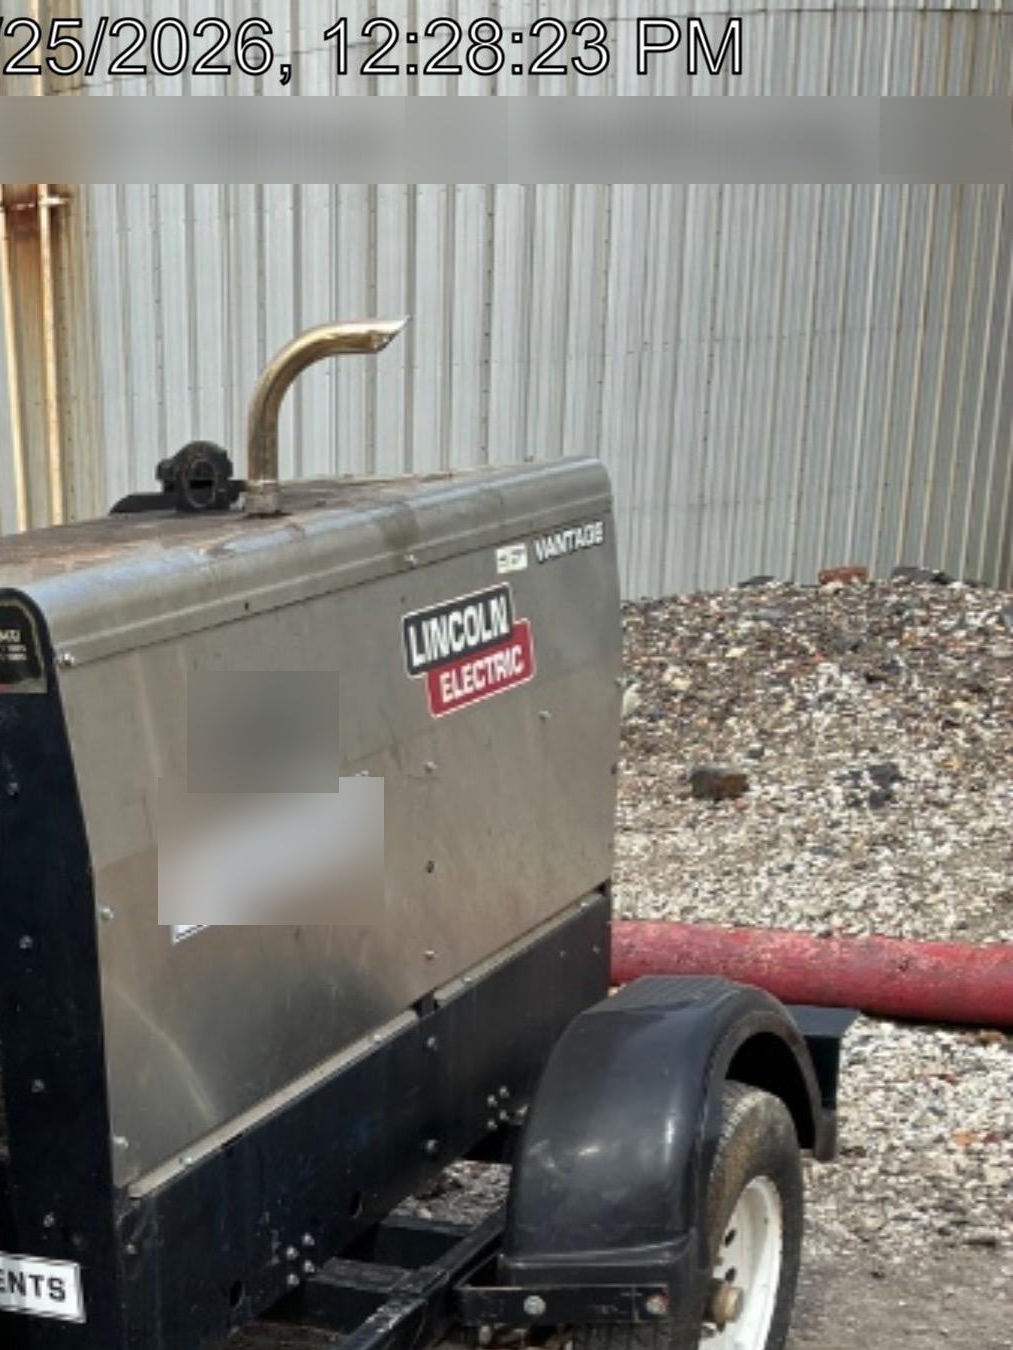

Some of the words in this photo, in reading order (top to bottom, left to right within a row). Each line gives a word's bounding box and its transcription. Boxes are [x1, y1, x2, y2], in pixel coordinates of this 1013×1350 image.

[535, 521, 603, 563] VANTAGE
[408, 595, 509, 667] LINCOLN
[439, 645, 524, 704] ELECTRIC
